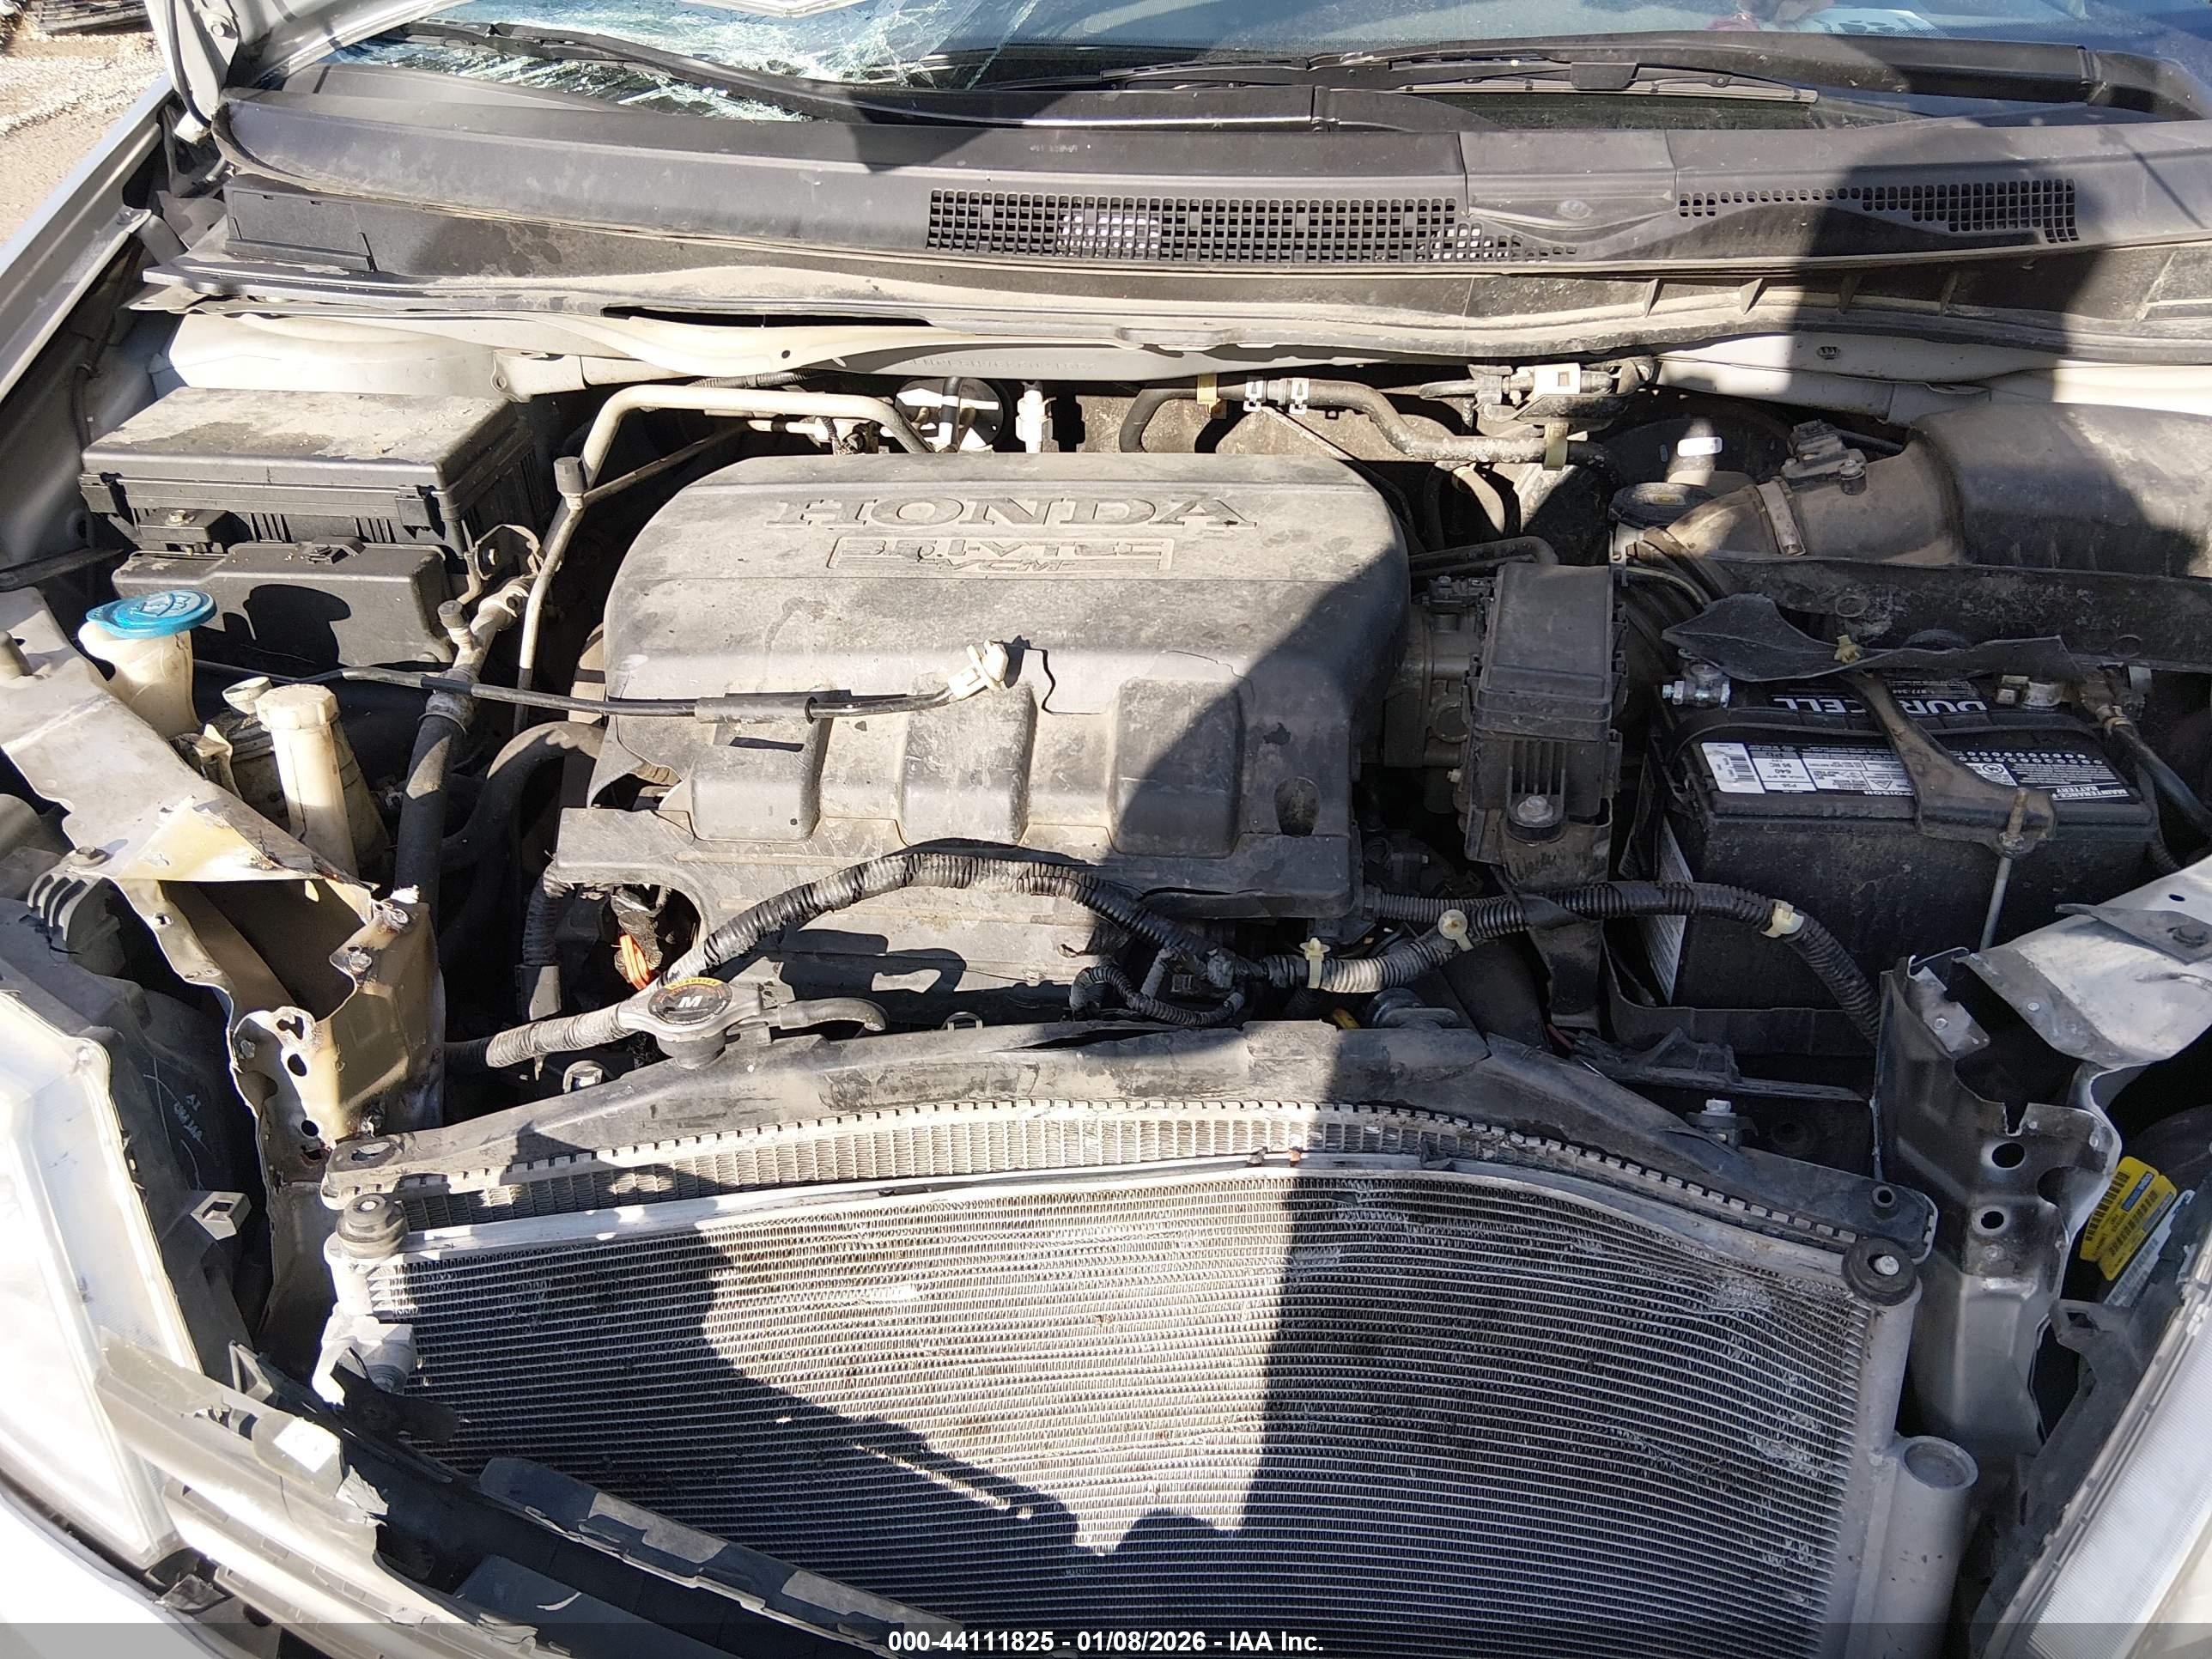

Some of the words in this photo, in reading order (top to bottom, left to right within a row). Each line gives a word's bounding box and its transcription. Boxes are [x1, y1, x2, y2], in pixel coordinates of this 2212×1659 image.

[766, 497, 1259, 527] HONDA
[1773, 698, 1988, 714] DURCELL
[2057, 785, 2099, 794] BATTERY
[678, 995, 703, 1008] M
